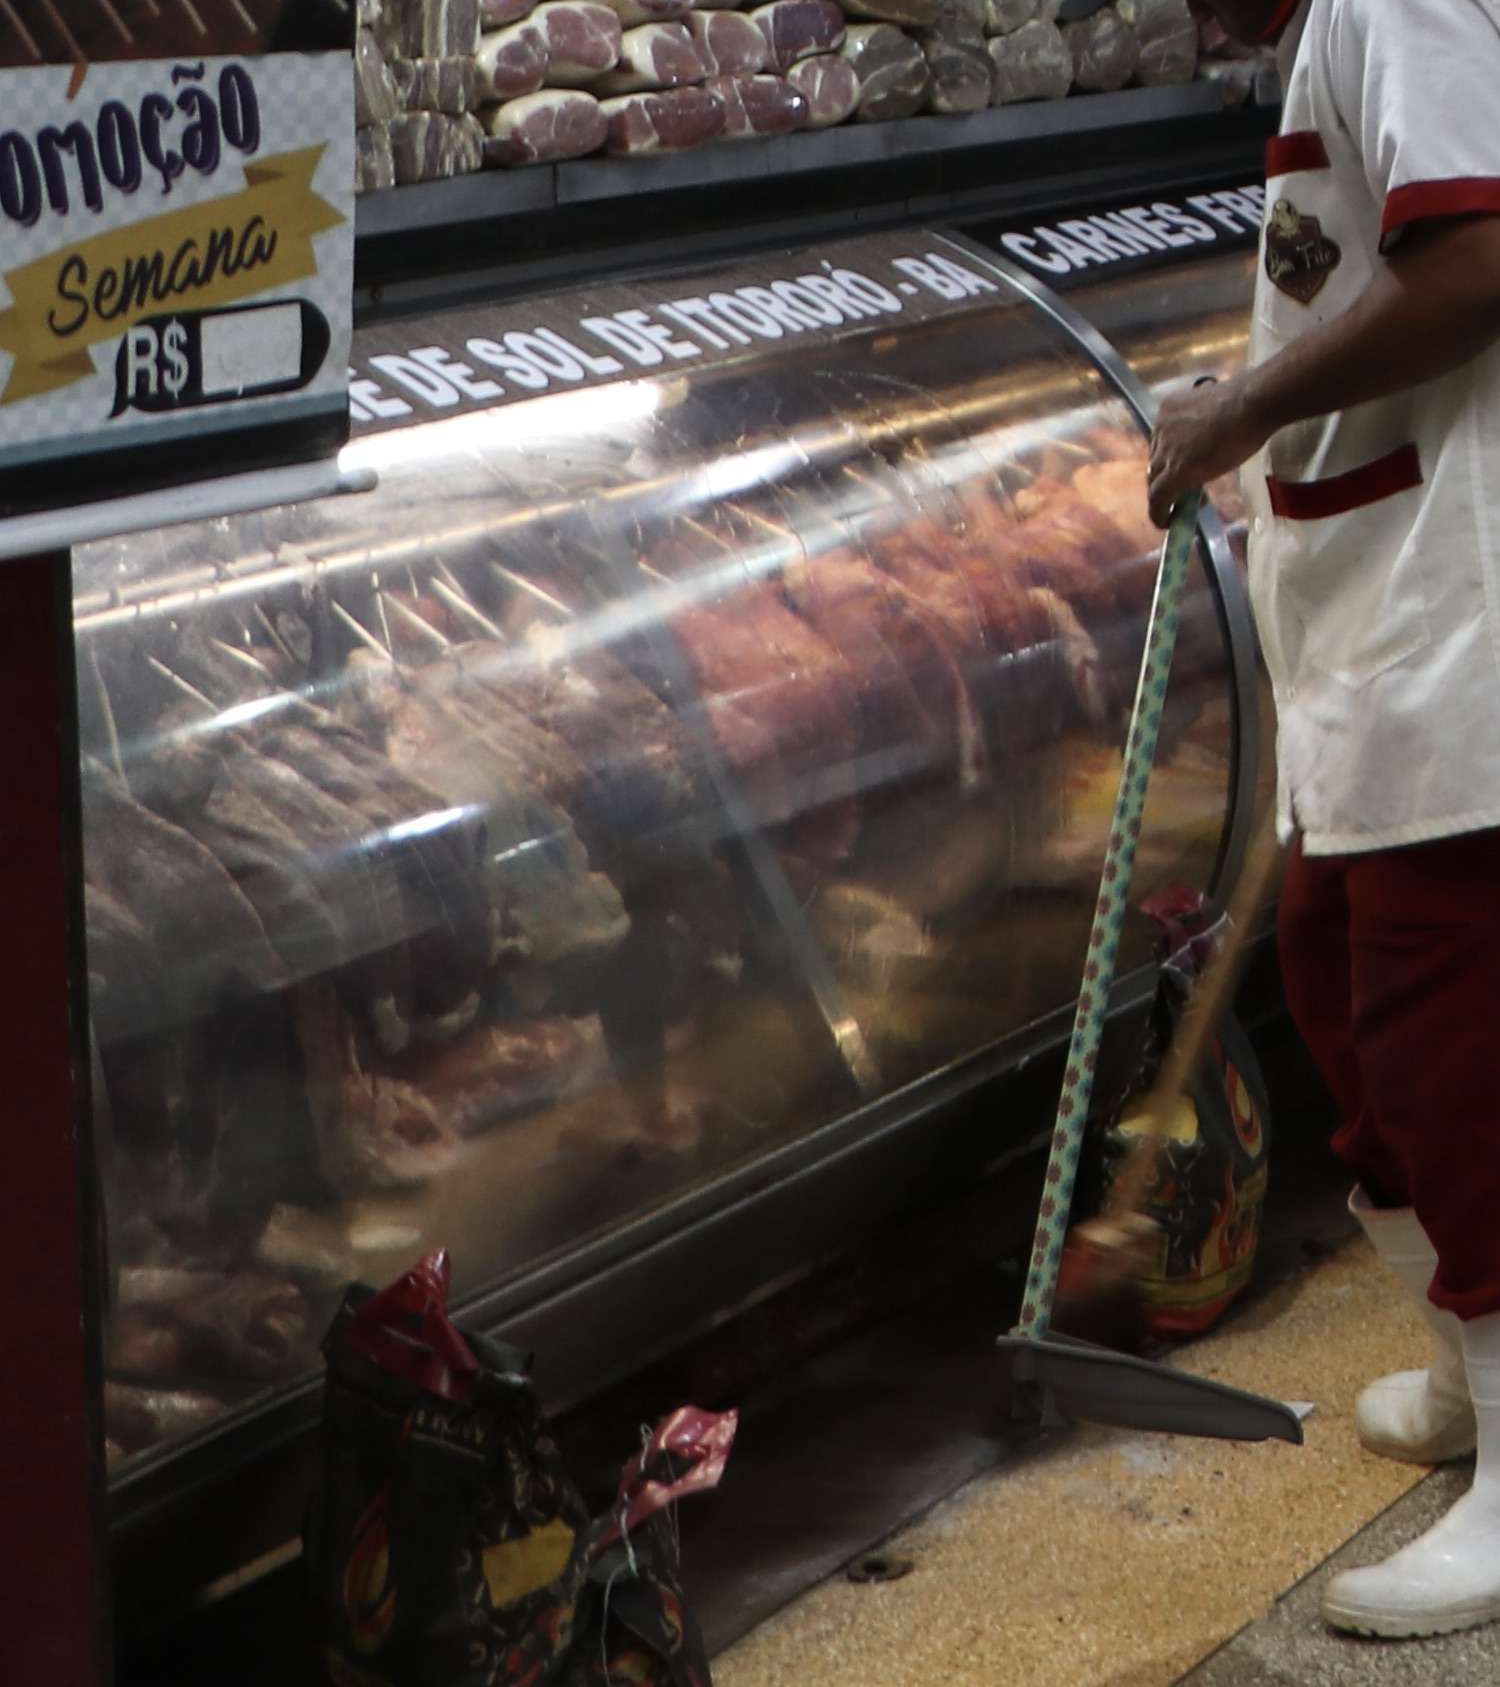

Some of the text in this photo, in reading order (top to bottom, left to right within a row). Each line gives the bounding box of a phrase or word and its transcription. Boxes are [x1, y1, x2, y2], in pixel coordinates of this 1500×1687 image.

[48, 215, 279, 338] Semana
[1001, 198, 1214, 277] CARNES
[127, 317, 190, 400] R$
[372, 342, 505, 410] DE
[466, 323, 600, 390] SOL
[601, 308, 701, 368] DE
[669, 259, 888, 357] ITORORÓ
[892, 252, 999, 304] BA
